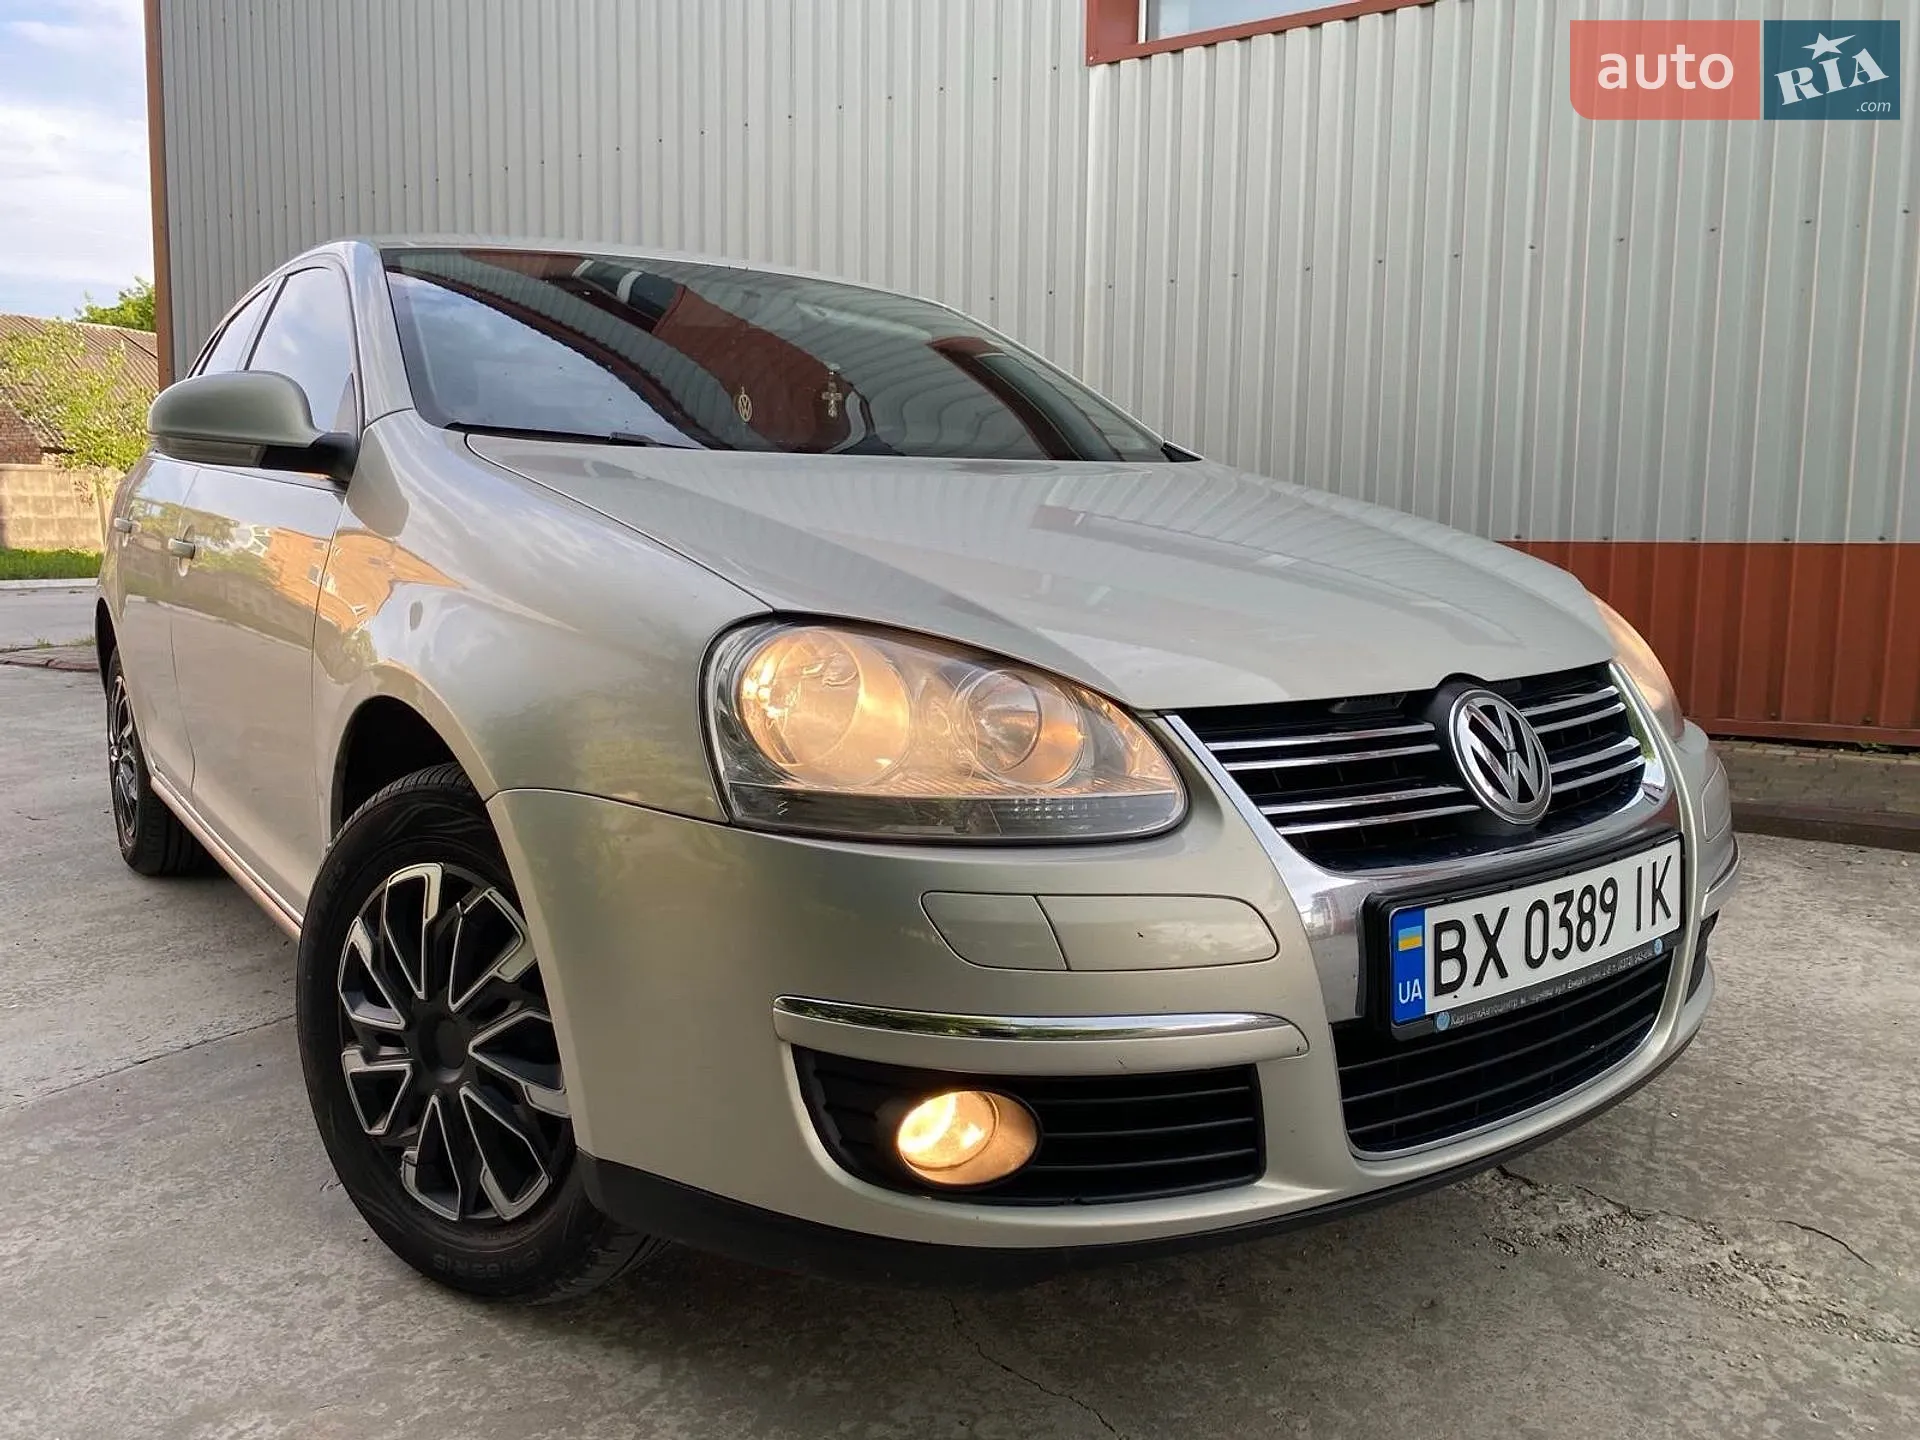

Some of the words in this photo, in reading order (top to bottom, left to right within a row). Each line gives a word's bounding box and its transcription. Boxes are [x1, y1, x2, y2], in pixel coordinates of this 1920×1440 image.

[1433, 906, 1510, 997] BX
[1524, 876, 1619, 970] 0389
[1635, 855, 1672, 932] IK
[1398, 978, 1423, 1005] UA
